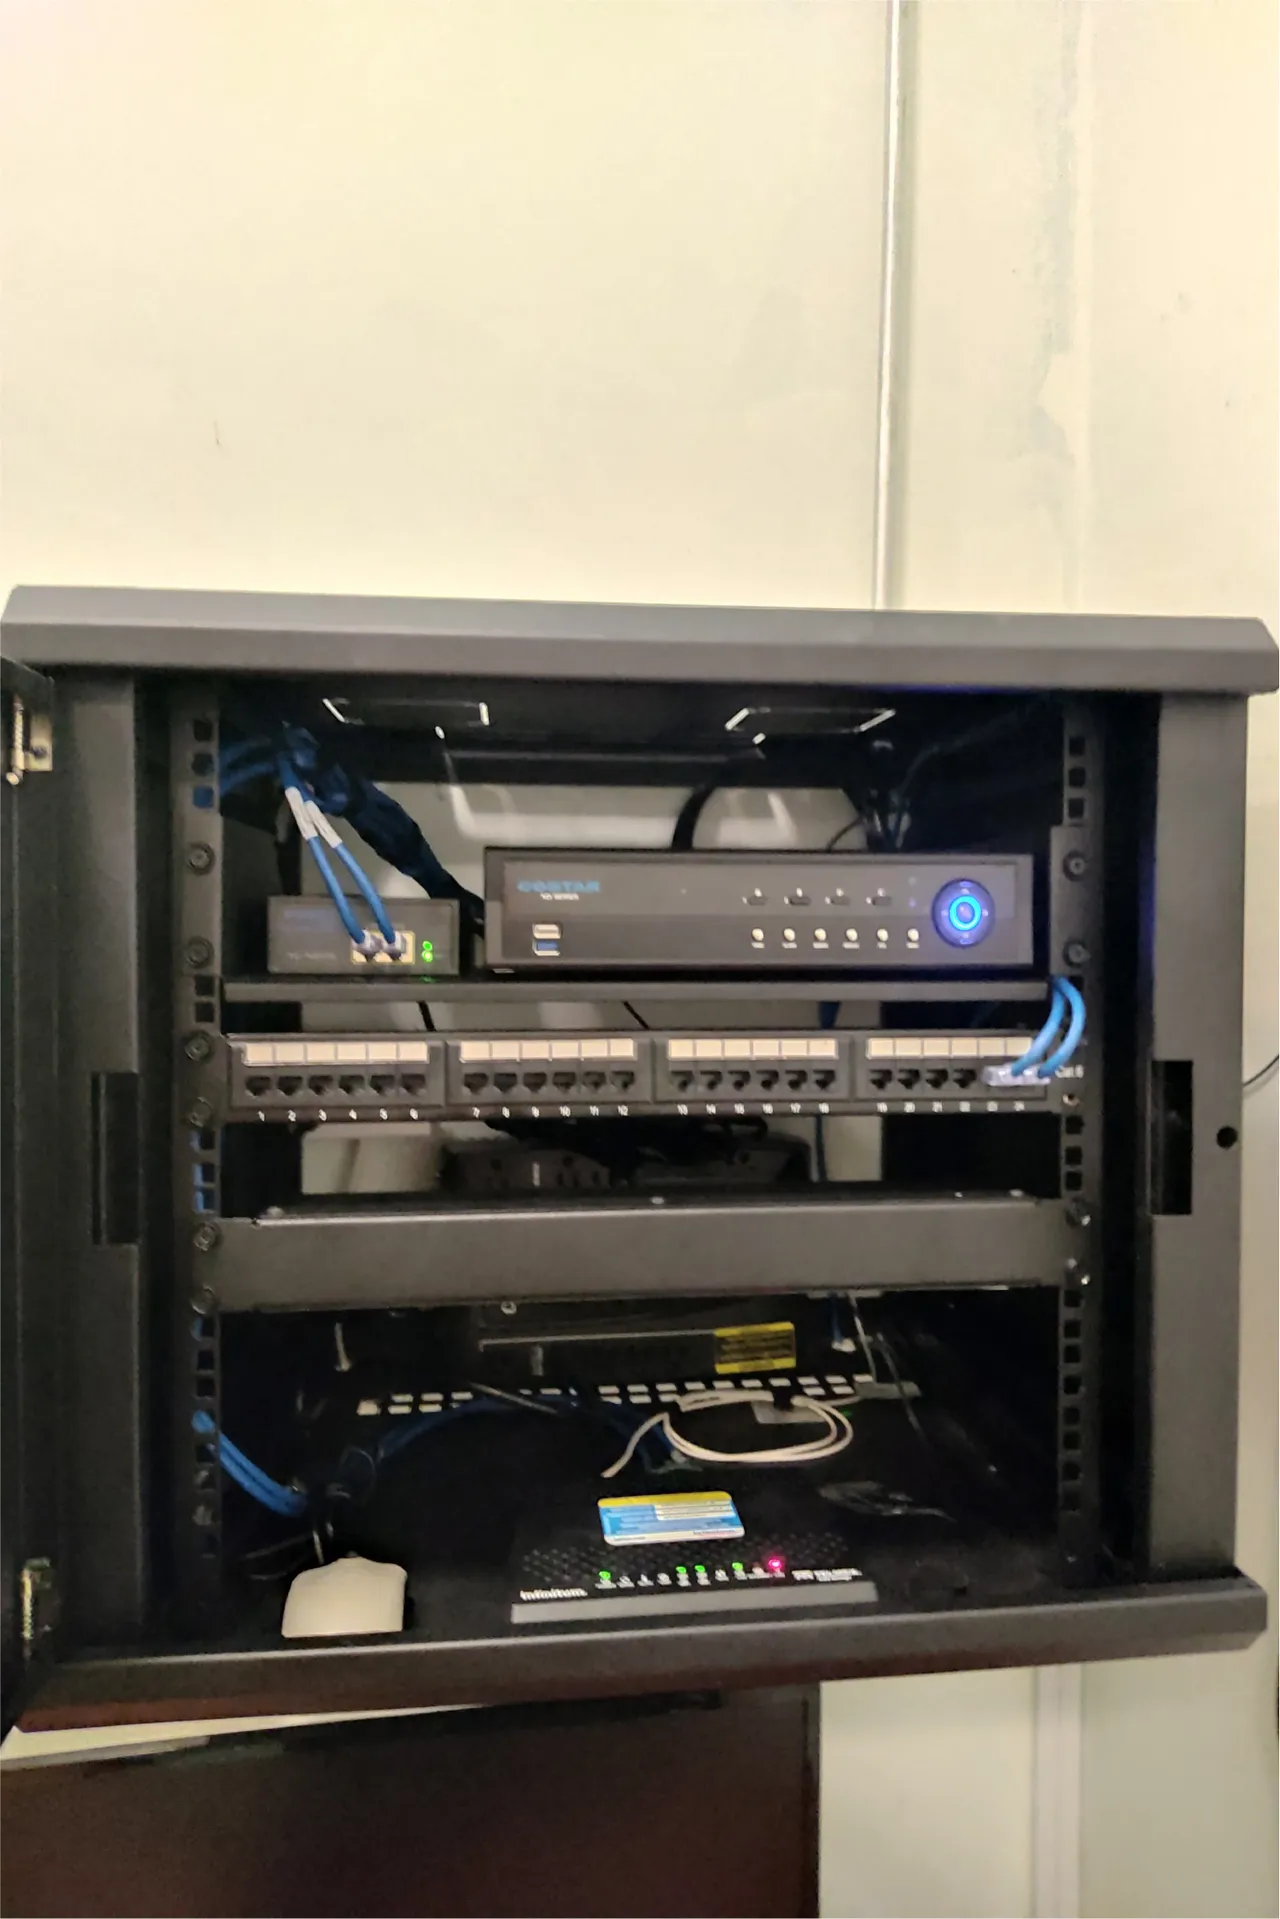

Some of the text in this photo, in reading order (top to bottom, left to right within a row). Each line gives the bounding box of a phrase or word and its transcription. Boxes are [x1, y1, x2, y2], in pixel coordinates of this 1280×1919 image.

[287, 1109, 297, 1122] 2
[559, 1105, 571, 1118] 10
[589, 1105, 600, 1117] 11
[617, 1104, 629, 1117] 12
